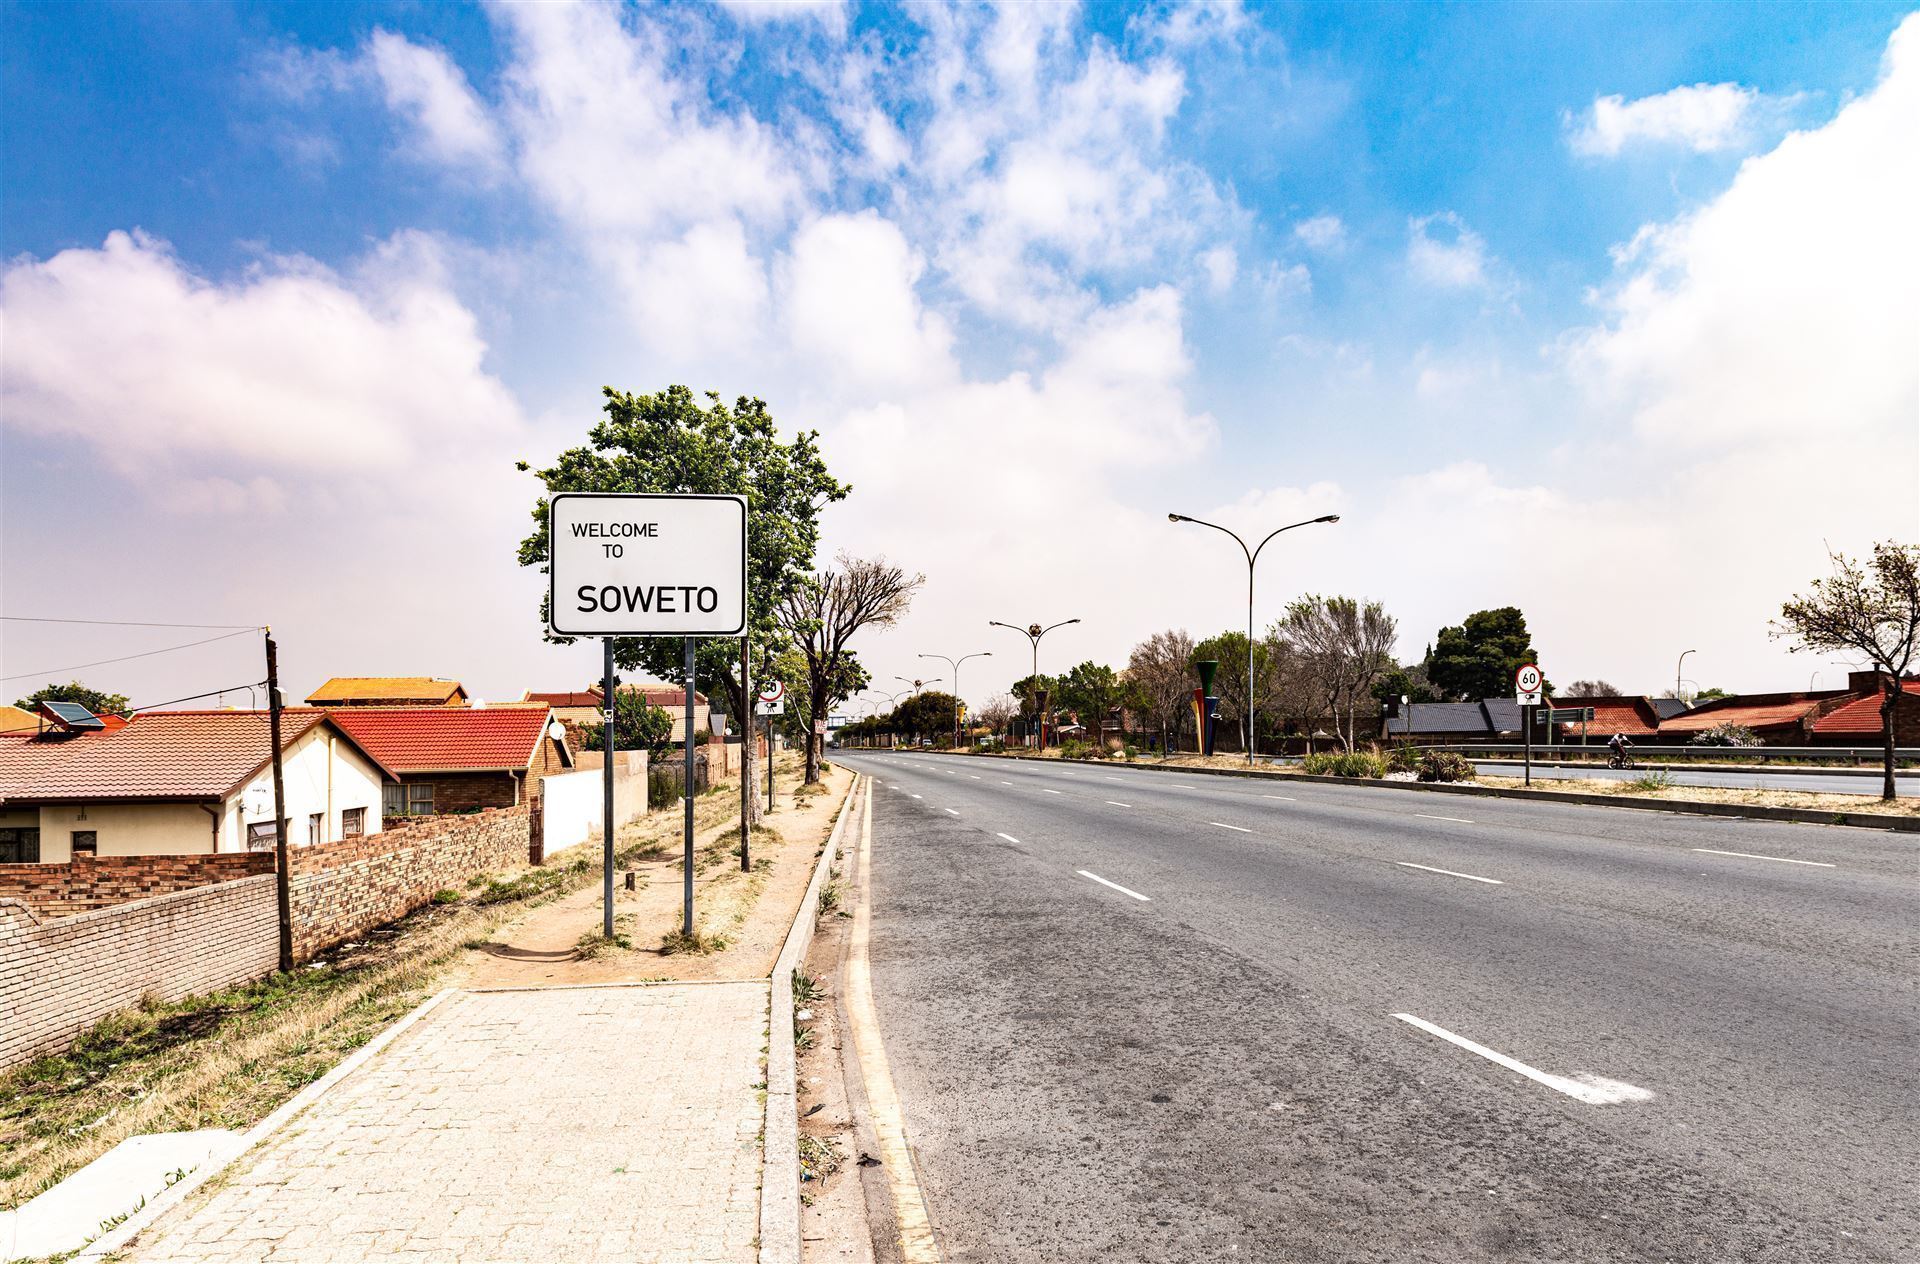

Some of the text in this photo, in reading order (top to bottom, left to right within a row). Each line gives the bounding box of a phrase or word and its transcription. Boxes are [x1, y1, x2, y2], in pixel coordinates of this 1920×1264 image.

[571, 523, 659, 538] WELCOME
[602, 544, 624, 558] TO
[576, 585, 718, 613] SOWETO
[1522, 673, 1536, 684] 60
